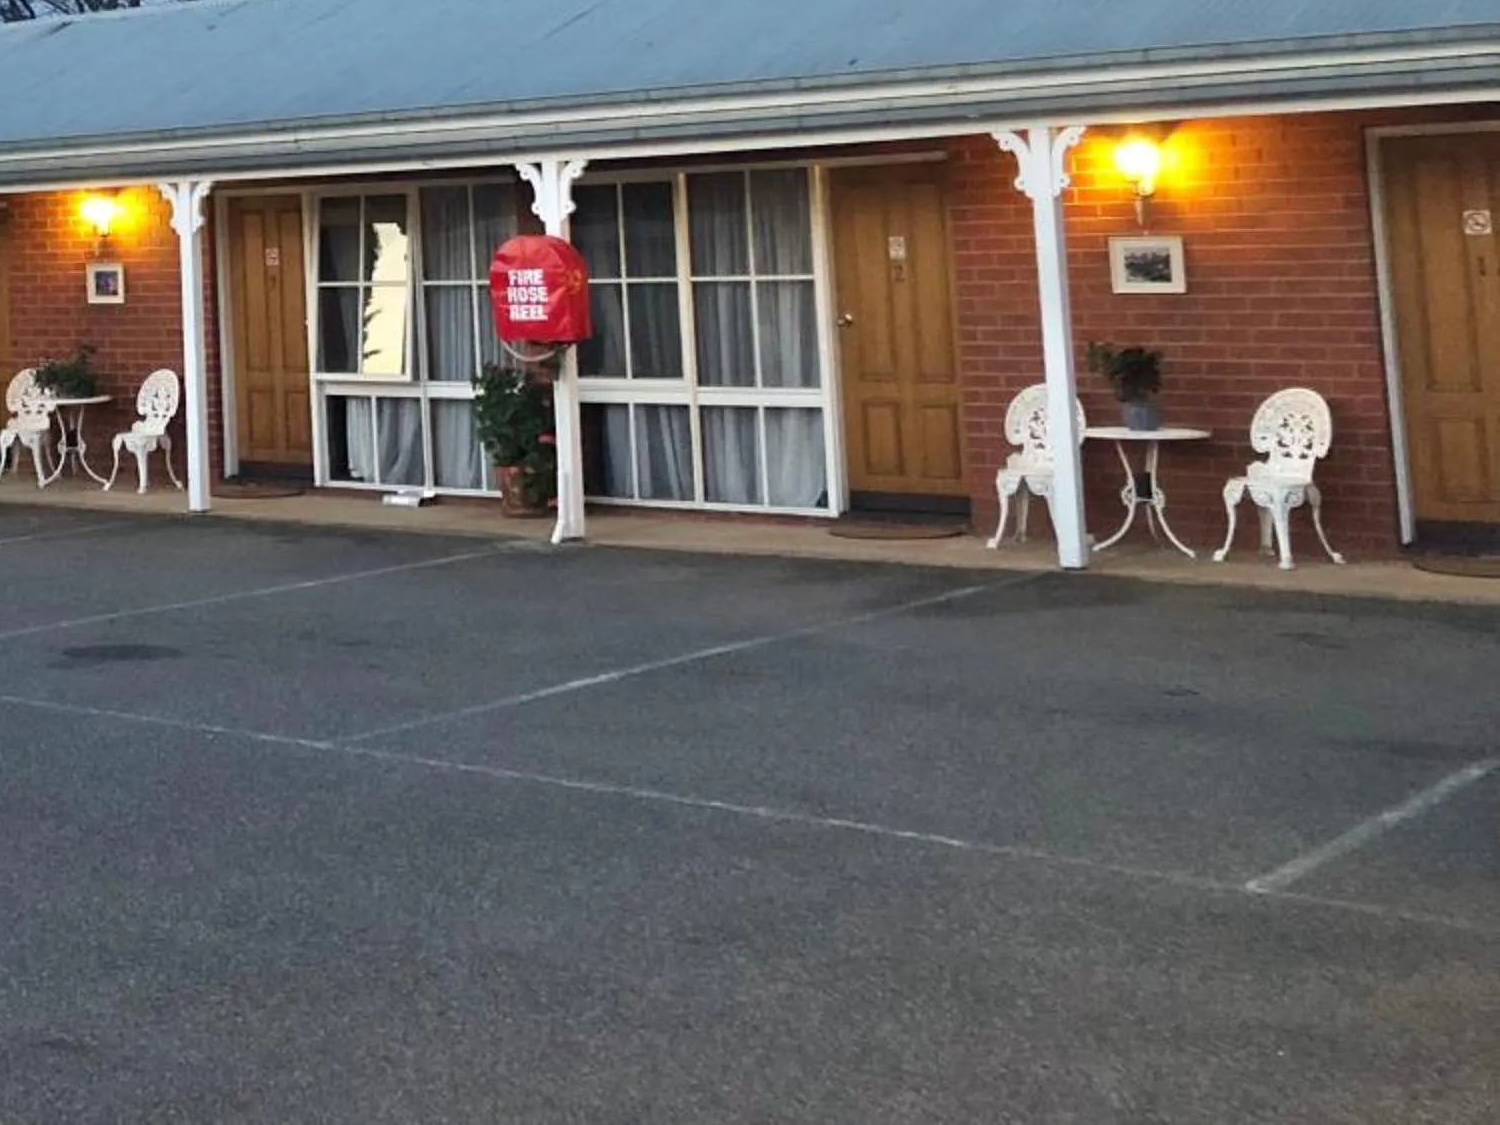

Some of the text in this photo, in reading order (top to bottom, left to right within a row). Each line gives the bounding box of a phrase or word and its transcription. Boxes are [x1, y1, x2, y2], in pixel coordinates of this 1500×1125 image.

[508, 268, 544, 285] FIRE
[508, 286, 548, 303] HOSE
[509, 304, 548, 321] REEL
